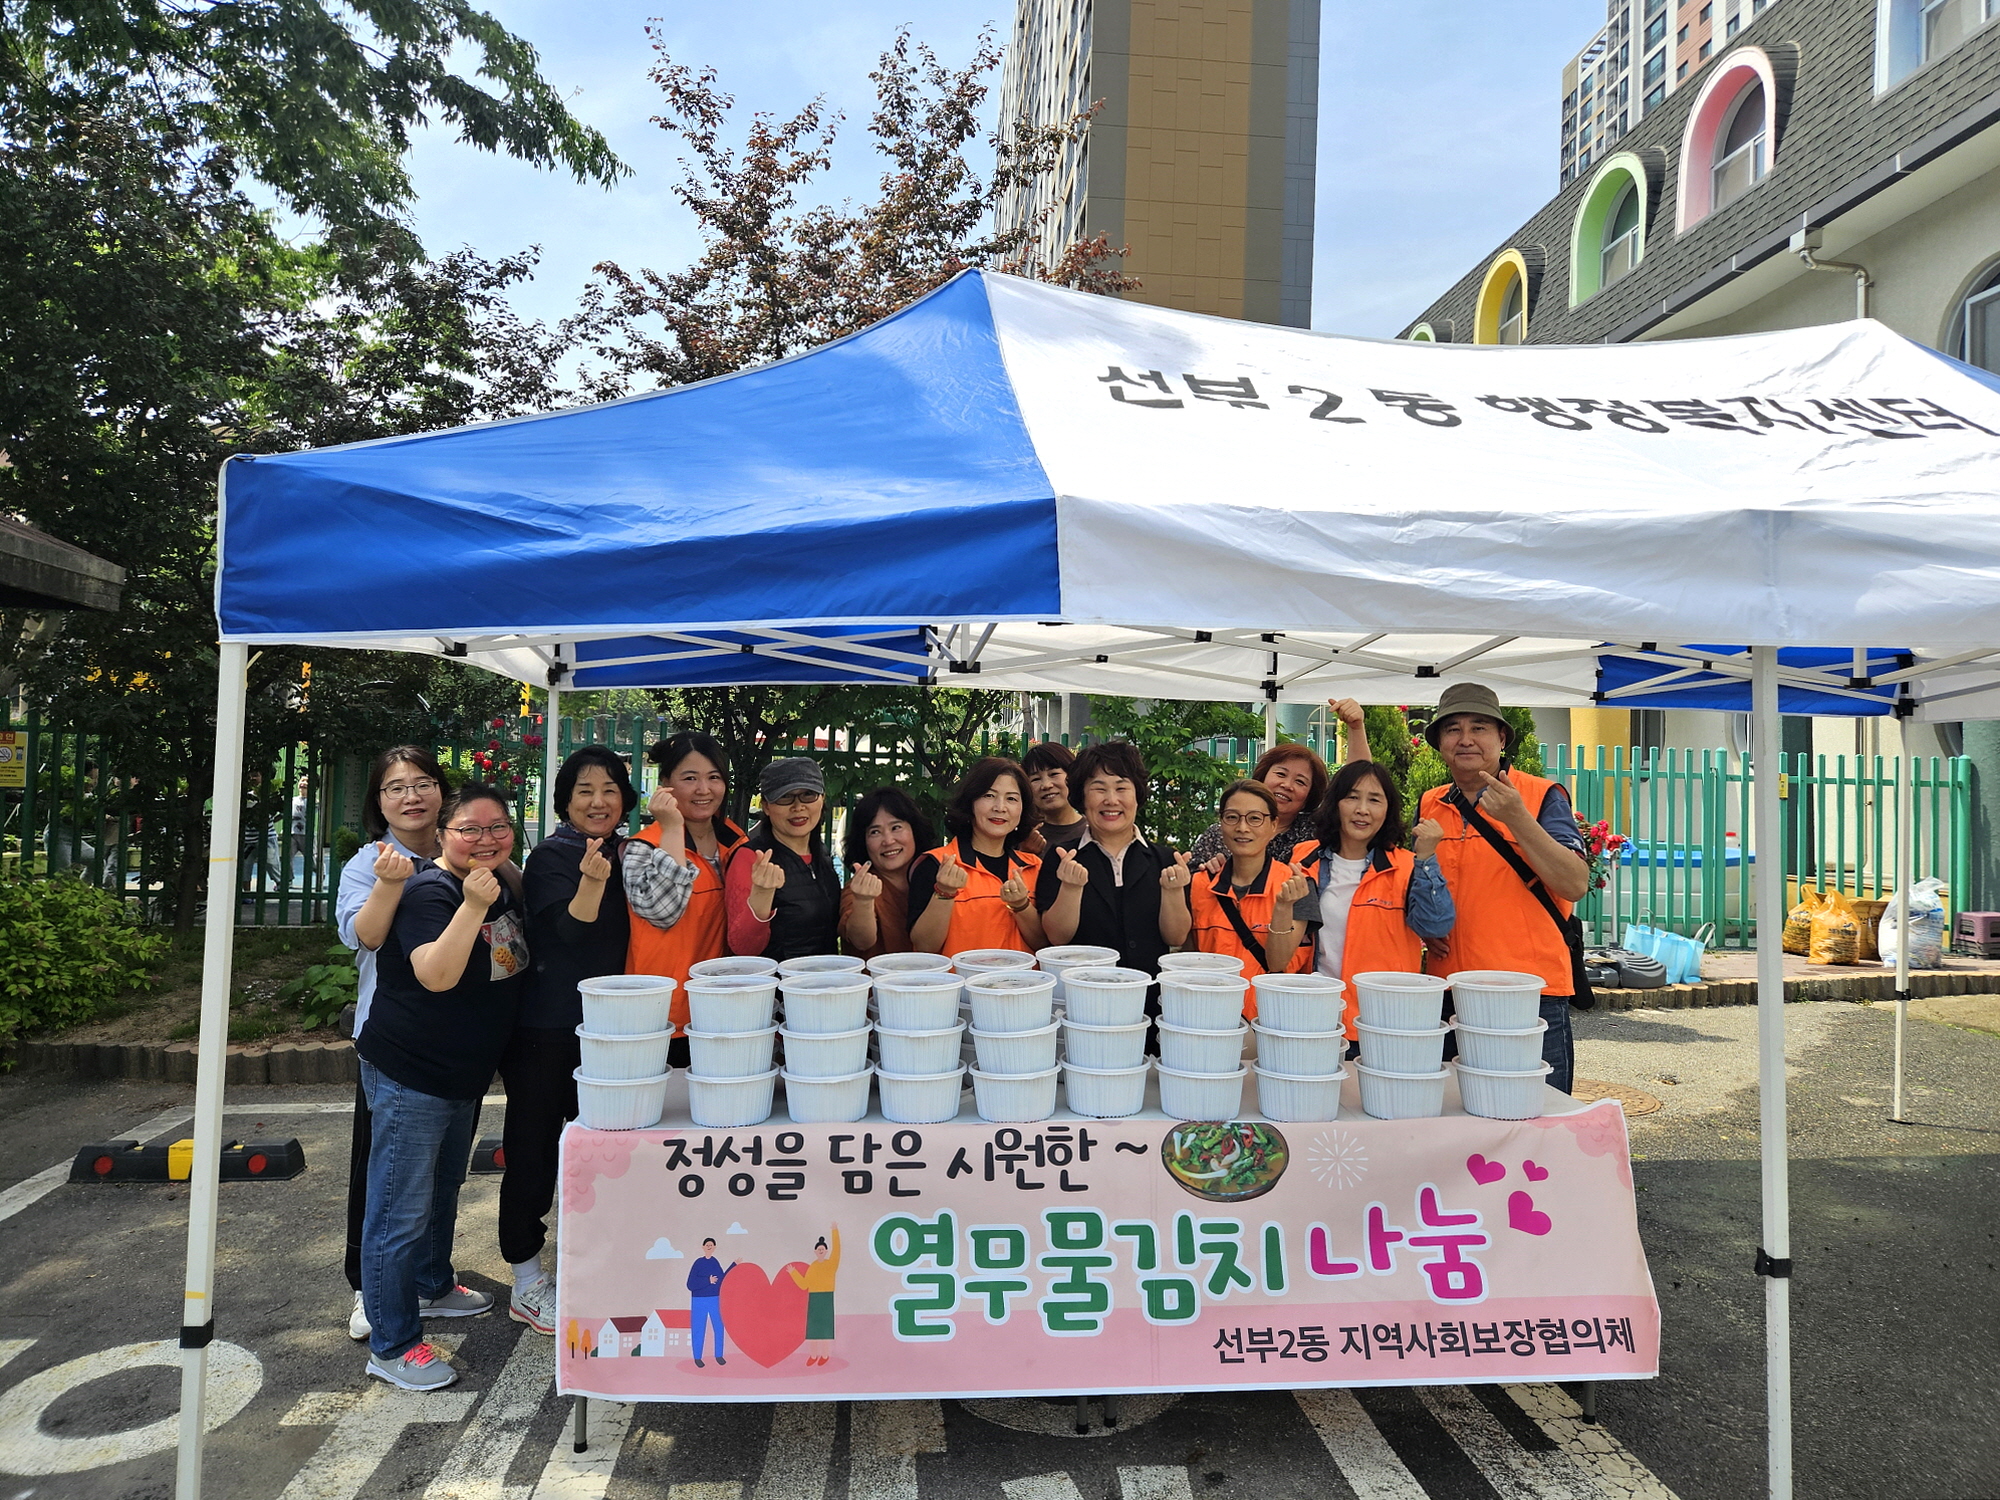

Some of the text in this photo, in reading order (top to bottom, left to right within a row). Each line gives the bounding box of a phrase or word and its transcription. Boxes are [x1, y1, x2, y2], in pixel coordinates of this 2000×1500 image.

[1097, 366, 2000, 438] 선부2동 행정복지센터
[663, 1131, 807, 1201] 정성을
[828, 1130, 928, 1197] 담은
[946, 1125, 1097, 1193] 시원한
[872, 1186, 1488, 1338] 열무물김치 나눔
[1212, 1315, 1637, 1364] 선부2동 지역사회보장협의체
